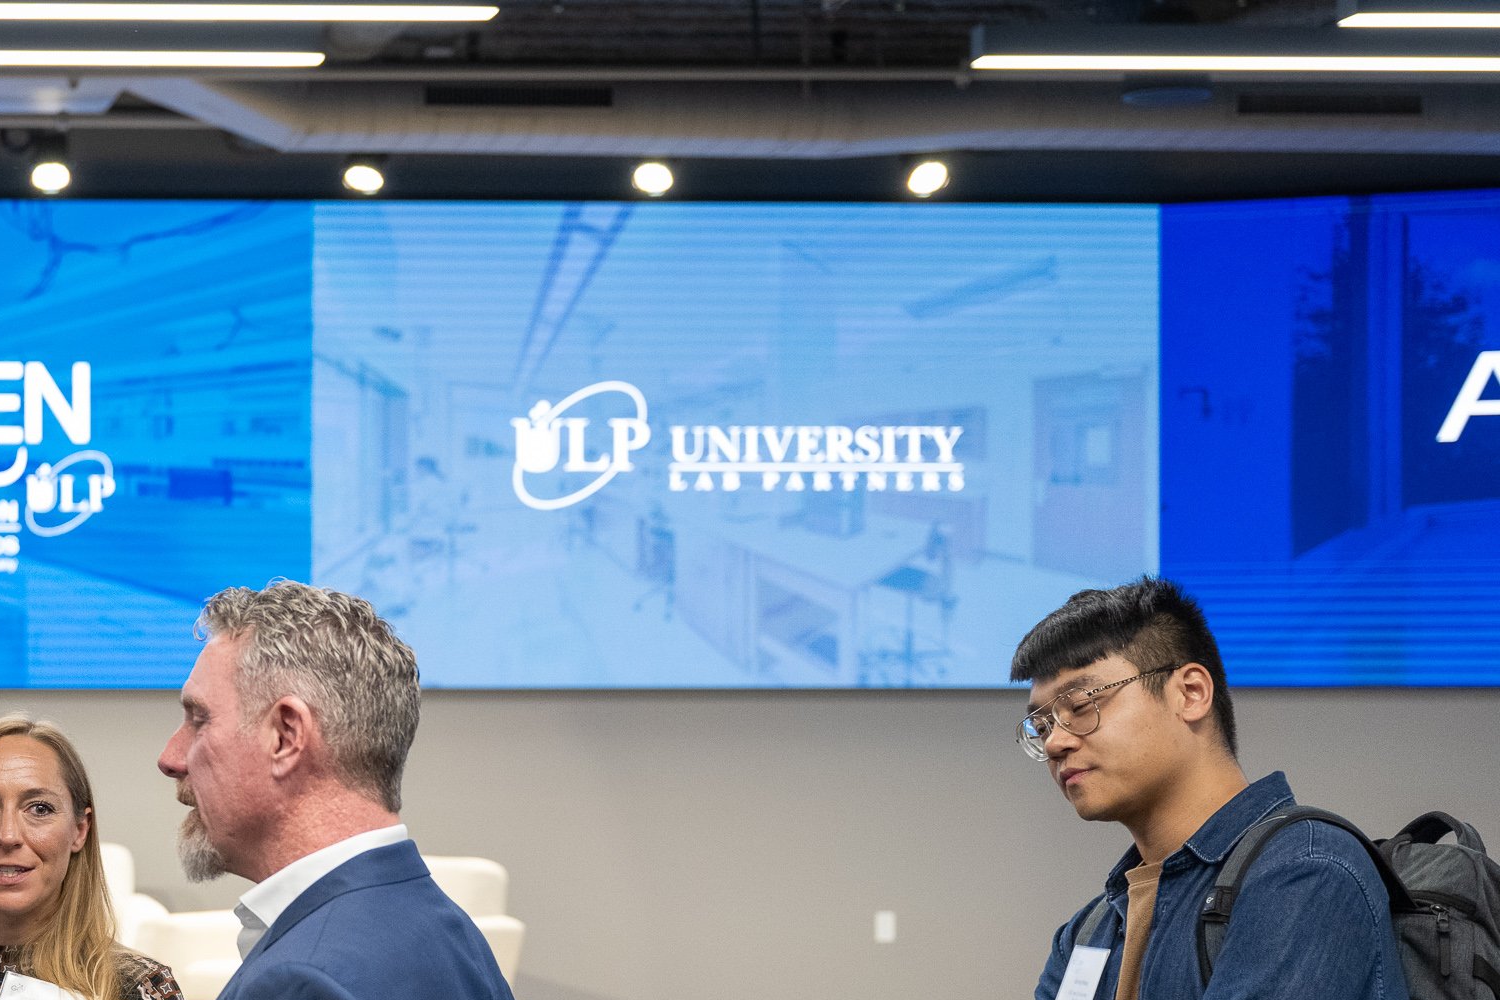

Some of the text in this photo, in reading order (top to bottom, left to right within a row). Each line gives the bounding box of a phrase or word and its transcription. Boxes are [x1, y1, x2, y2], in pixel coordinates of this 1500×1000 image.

[510, 399, 651, 473] ULP
[670, 425, 964, 464] UNIVERSITY
[668, 471, 965, 492] LAB PARTNERS
